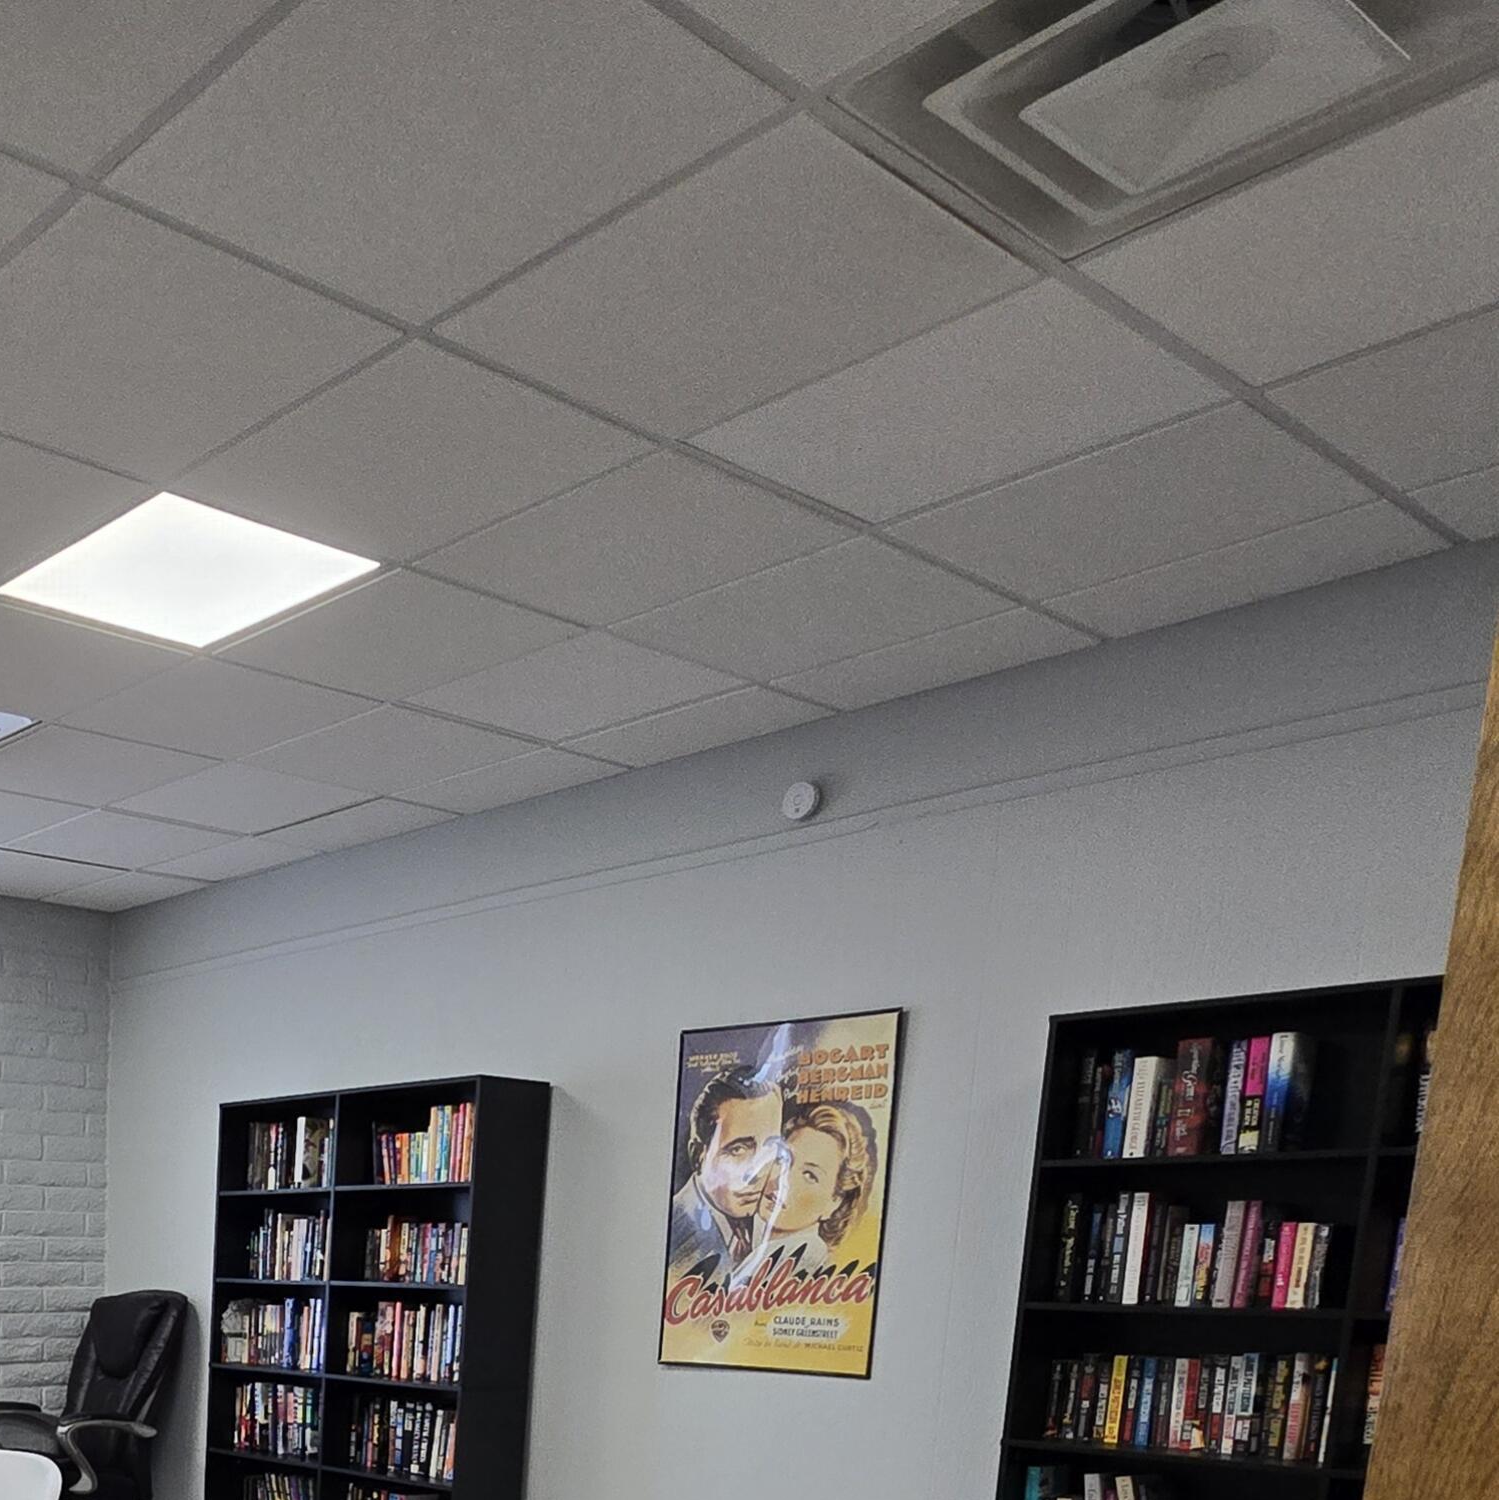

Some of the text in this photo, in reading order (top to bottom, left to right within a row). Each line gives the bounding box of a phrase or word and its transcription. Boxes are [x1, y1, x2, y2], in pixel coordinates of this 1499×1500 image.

[799, 1044, 889, 1066] BOGART
[798, 1063, 889, 1085] BERGMAN
[797, 1083, 888, 1104] HENREID
[664, 1257, 872, 1326] Casablanca
[773, 1315, 806, 1326] CLAUDE
[810, 1317, 840, 1328] RAINS
